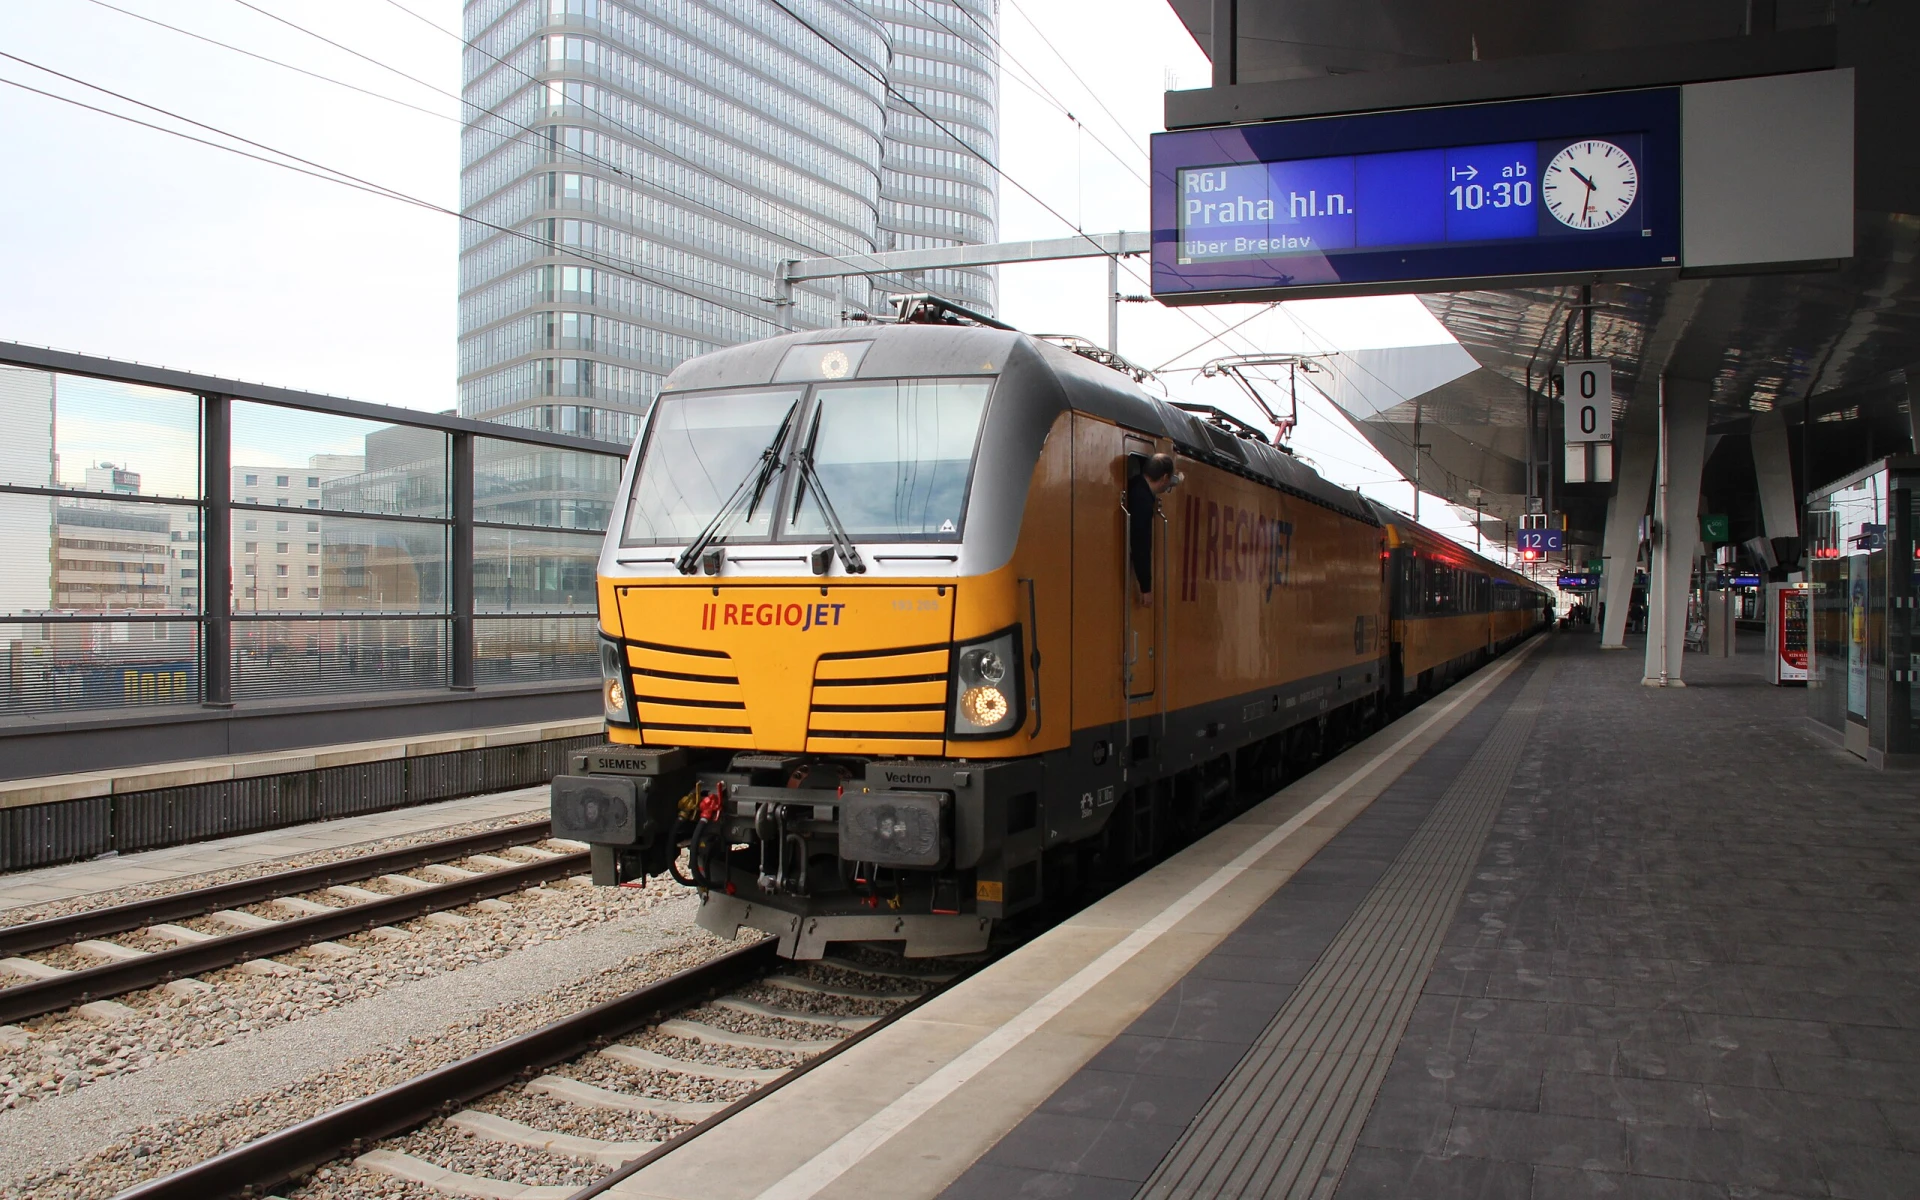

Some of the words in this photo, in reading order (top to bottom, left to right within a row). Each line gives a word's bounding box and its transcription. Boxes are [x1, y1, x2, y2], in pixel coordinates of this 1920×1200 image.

[1502, 161, 1527, 178] ab
[1185, 171, 1227, 194] RGJ
[1449, 181, 1532, 211] 10:30
[1185, 196, 1274, 226] Praha
[1290, 190, 1353, 218] hl.n.
[1186, 240, 1228, 255] über
[1234, 234, 1311, 252] Breclav
[1523, 533, 1542, 548] 12
[1547, 536, 1557, 548] C
[1205, 500, 1293, 604] REGIOJET
[723, 603, 846, 632] REGIOJET
[598, 758, 647, 770] SIEMENS
[885, 771, 932, 784] Vectron
